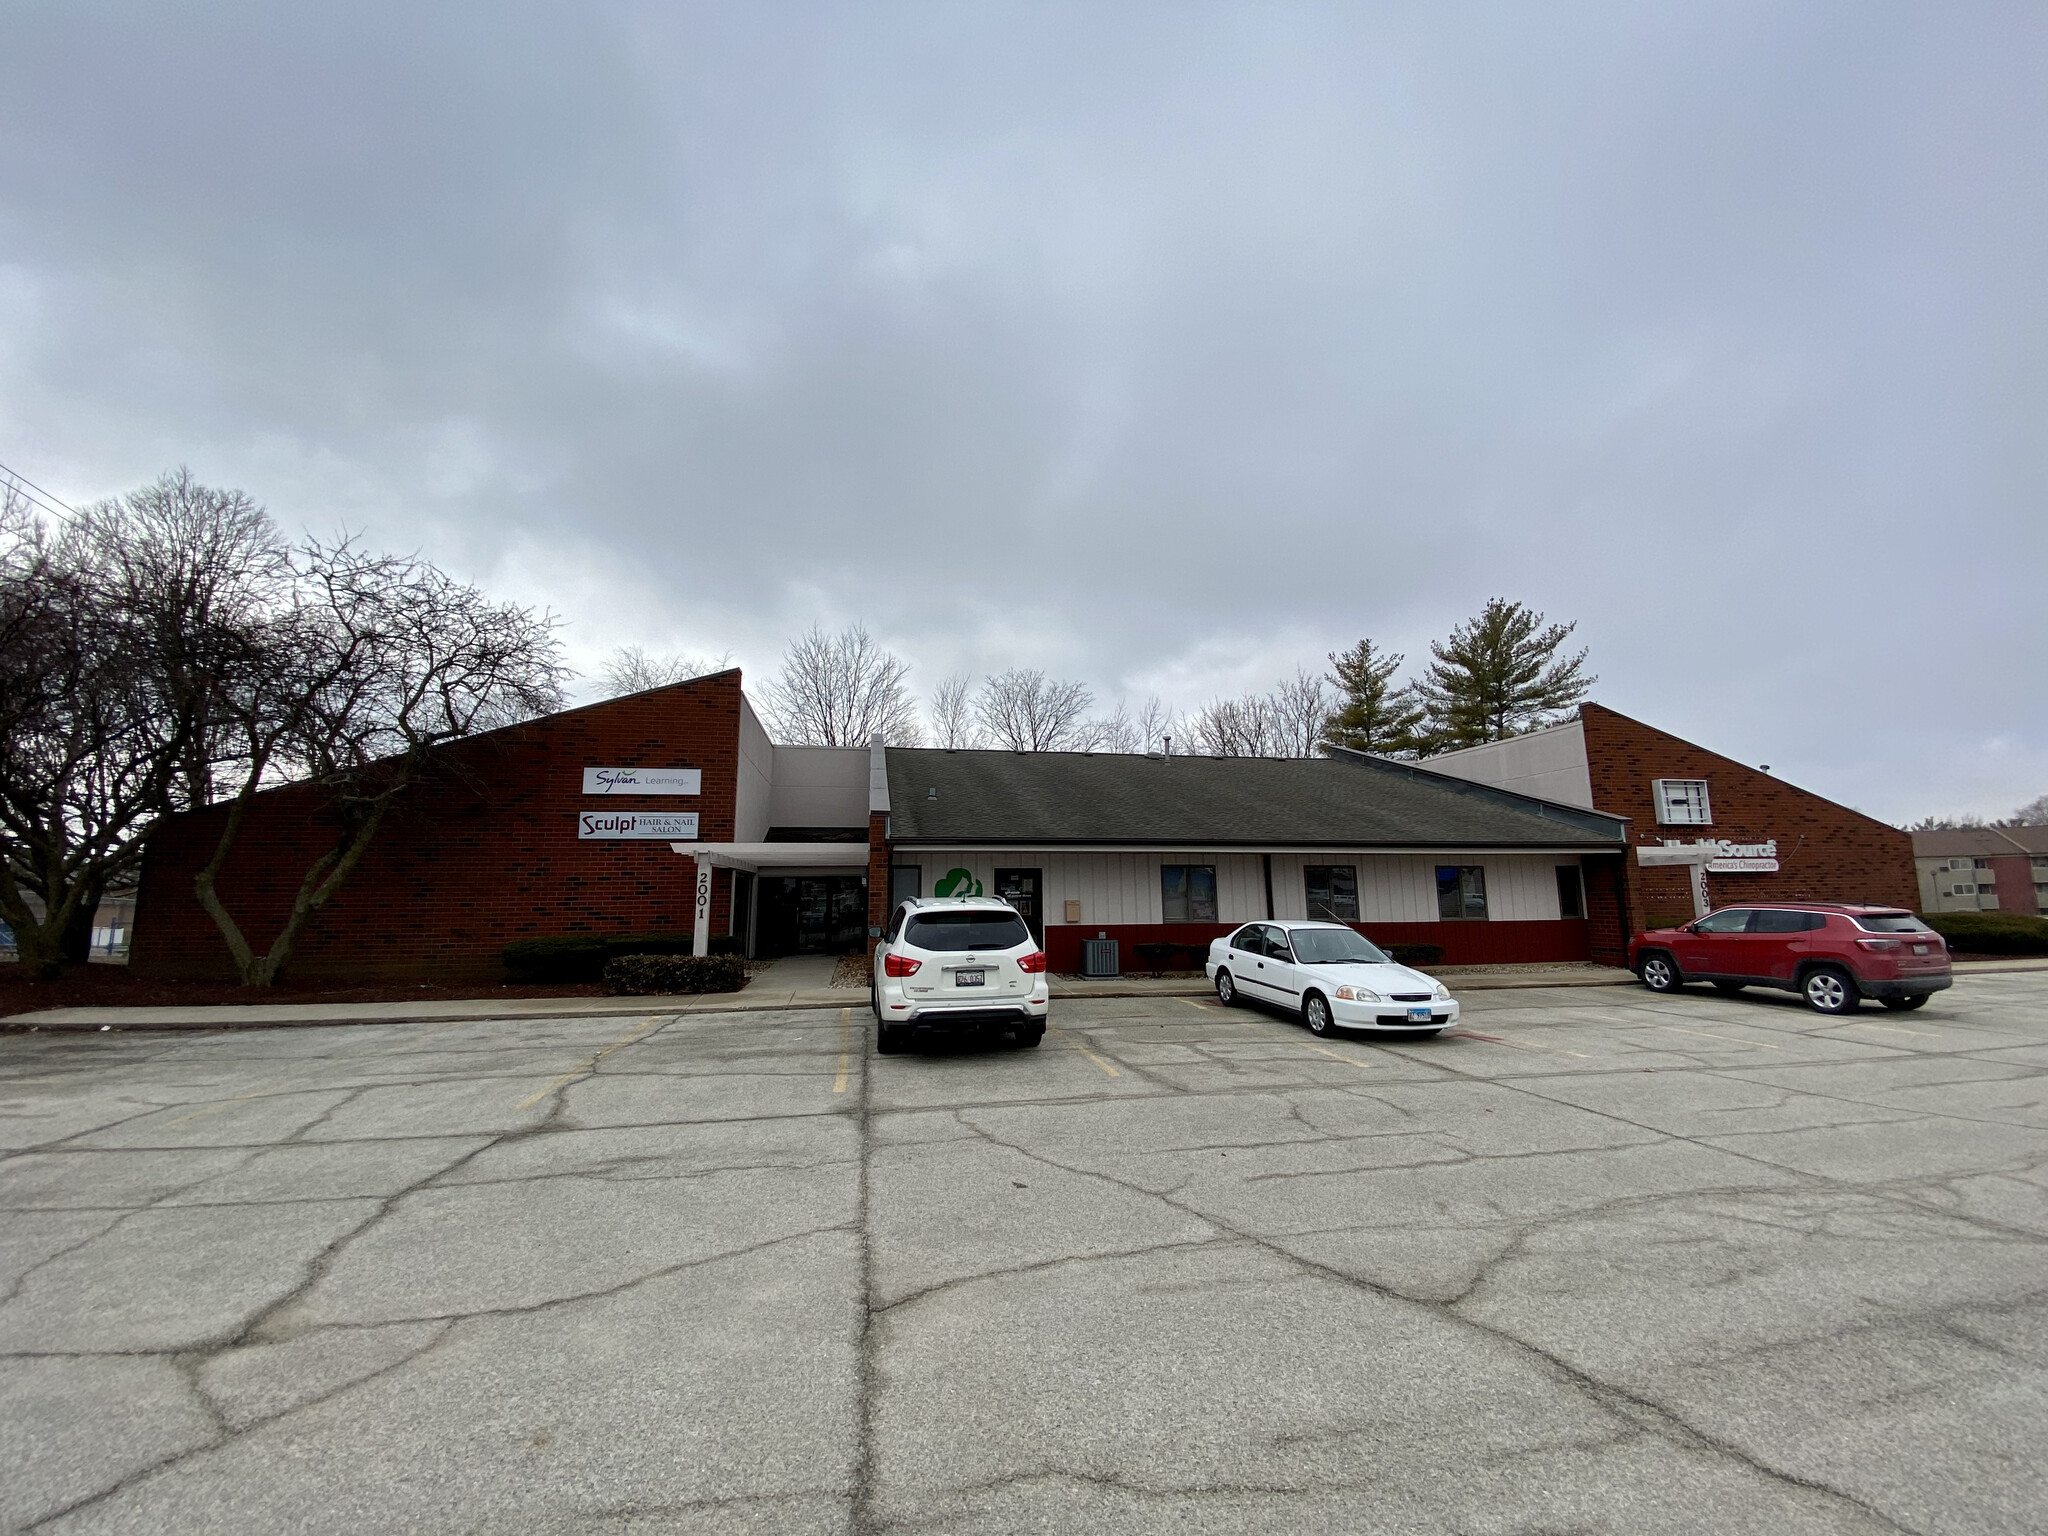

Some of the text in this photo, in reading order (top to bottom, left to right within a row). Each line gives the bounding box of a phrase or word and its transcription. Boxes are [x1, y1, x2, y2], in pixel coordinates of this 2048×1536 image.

[596, 770, 684, 792] Sylvan Learning
[582, 815, 637, 835] Sculpt
[1739, 860, 1777, 870] Chiropractor
[697, 873, 708, 919] 2001
[1700, 873, 1709, 907] 2003
